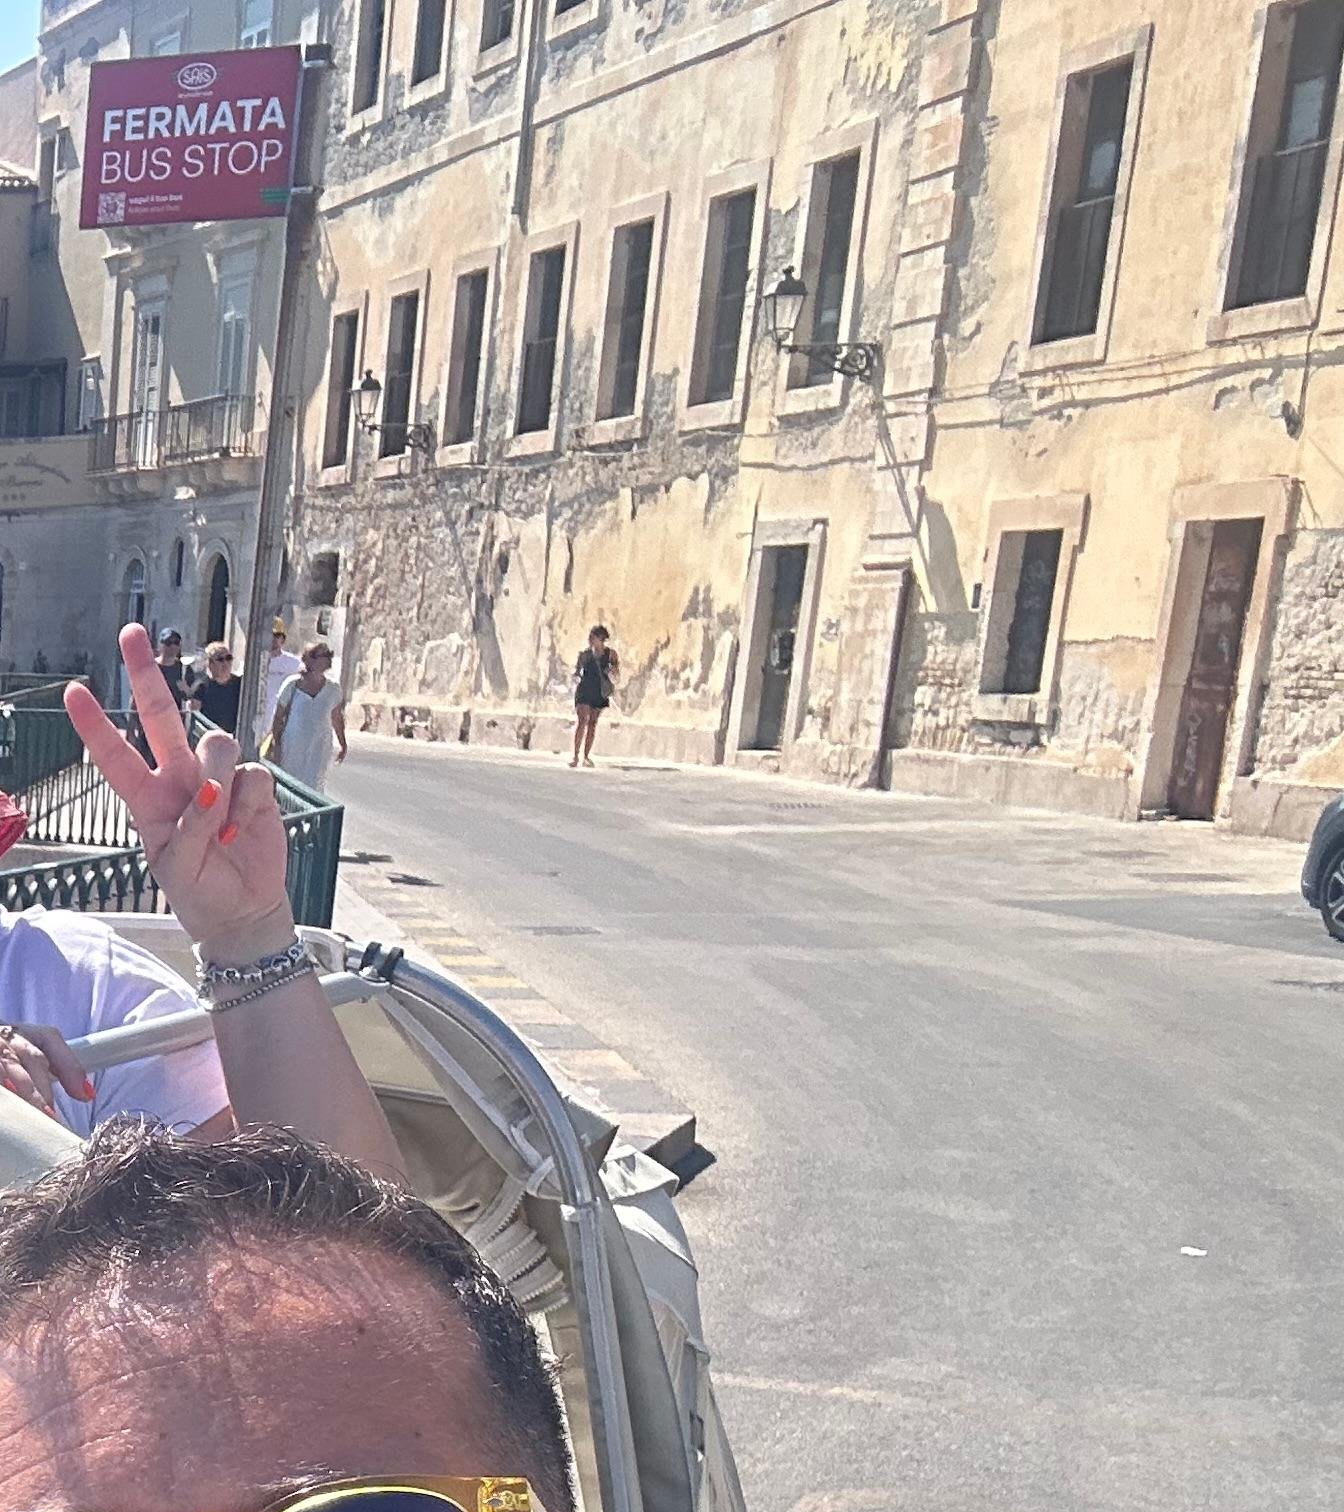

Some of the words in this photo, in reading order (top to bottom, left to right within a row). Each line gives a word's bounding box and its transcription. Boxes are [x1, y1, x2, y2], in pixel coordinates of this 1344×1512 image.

[103, 97, 286, 142] FERMATA
[100, 147, 172, 184] BUS
[182, 139, 283, 178] STOP
